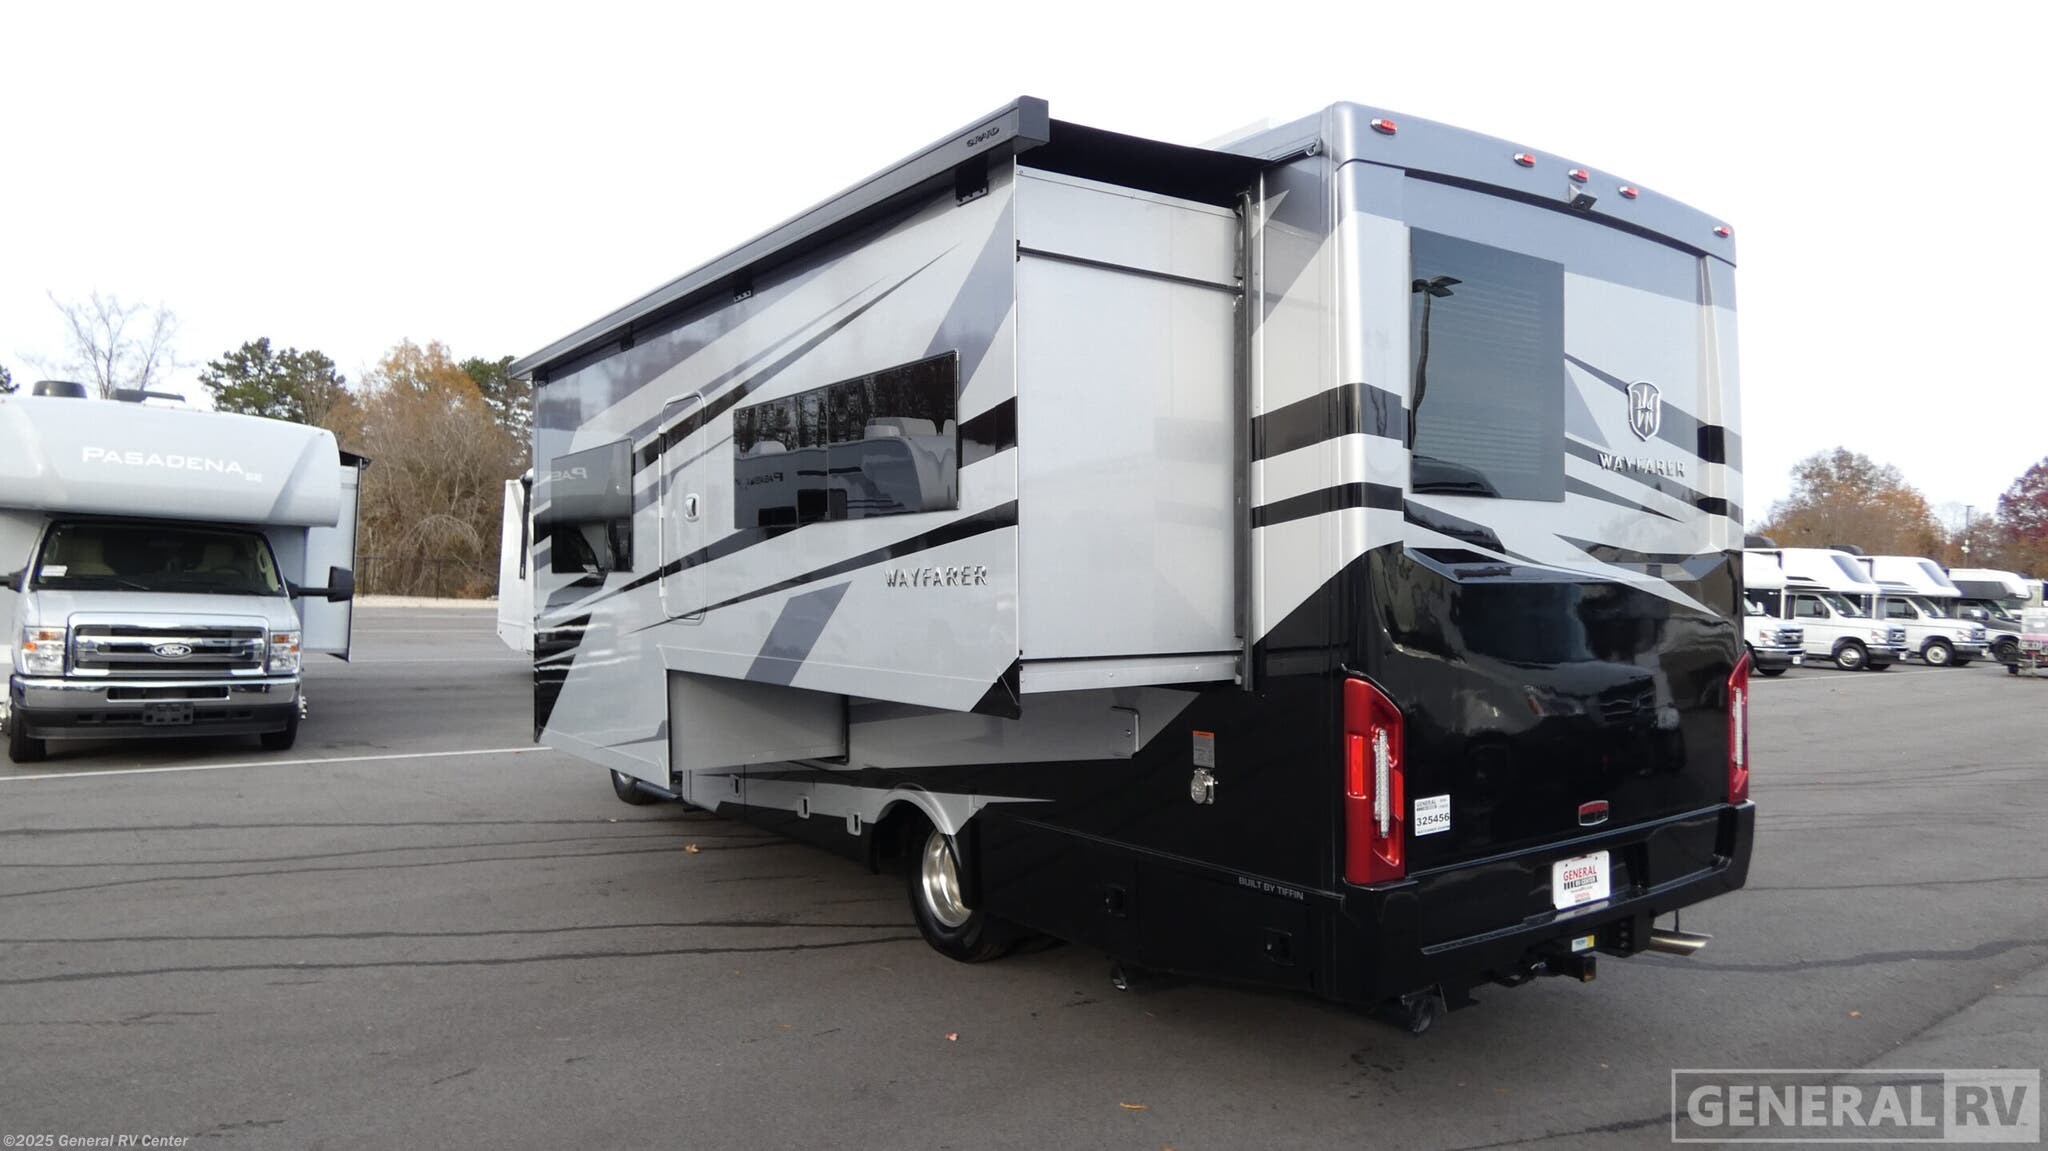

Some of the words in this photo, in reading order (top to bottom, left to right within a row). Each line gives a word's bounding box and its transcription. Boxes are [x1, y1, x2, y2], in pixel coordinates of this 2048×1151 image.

[82, 446, 244, 474] PASADENA
[1597, 452, 1686, 478] WAYFARER
[884, 565, 988, 588] WAYFARER
[1416, 813, 1450, 827] 325456
[1563, 864, 1597, 881] GENERAL
[1238, 876, 1262, 889] BUILT
[1263, 882, 1276, 893] BY
[1276, 885, 1304, 900] TIFFIN
